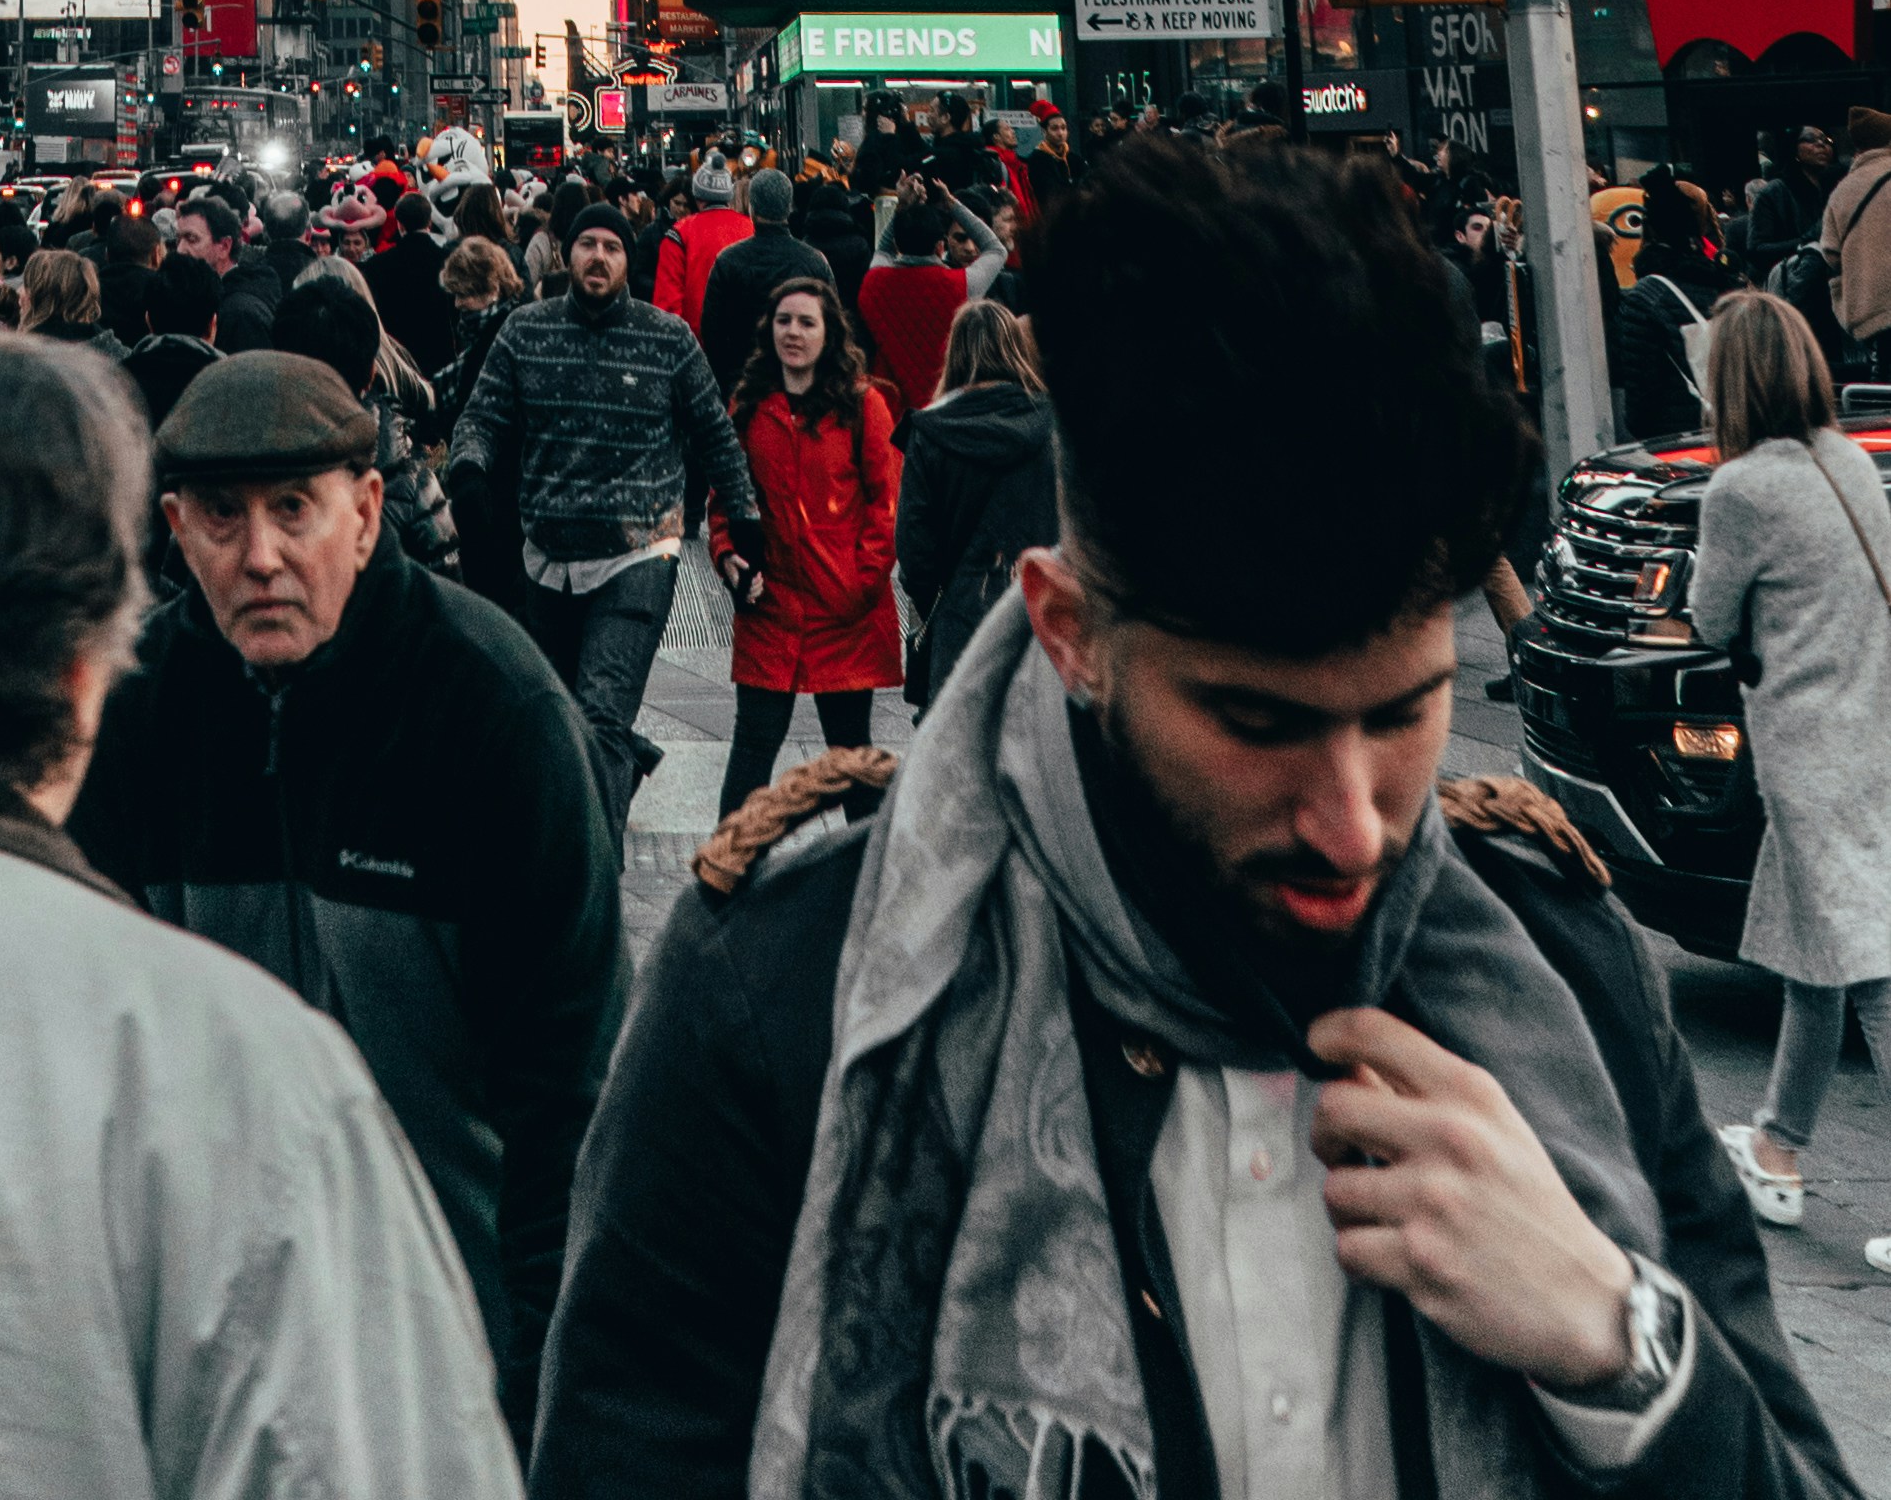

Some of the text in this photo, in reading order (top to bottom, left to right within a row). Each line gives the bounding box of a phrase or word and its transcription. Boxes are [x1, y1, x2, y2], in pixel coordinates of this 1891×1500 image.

[669, 24, 706, 35] MARKET
[1162, 11, 1256, 30] KEEP MOVING
[834, 27, 977, 57] FRIENDS
[664, 85, 718, 103] CARMINES
